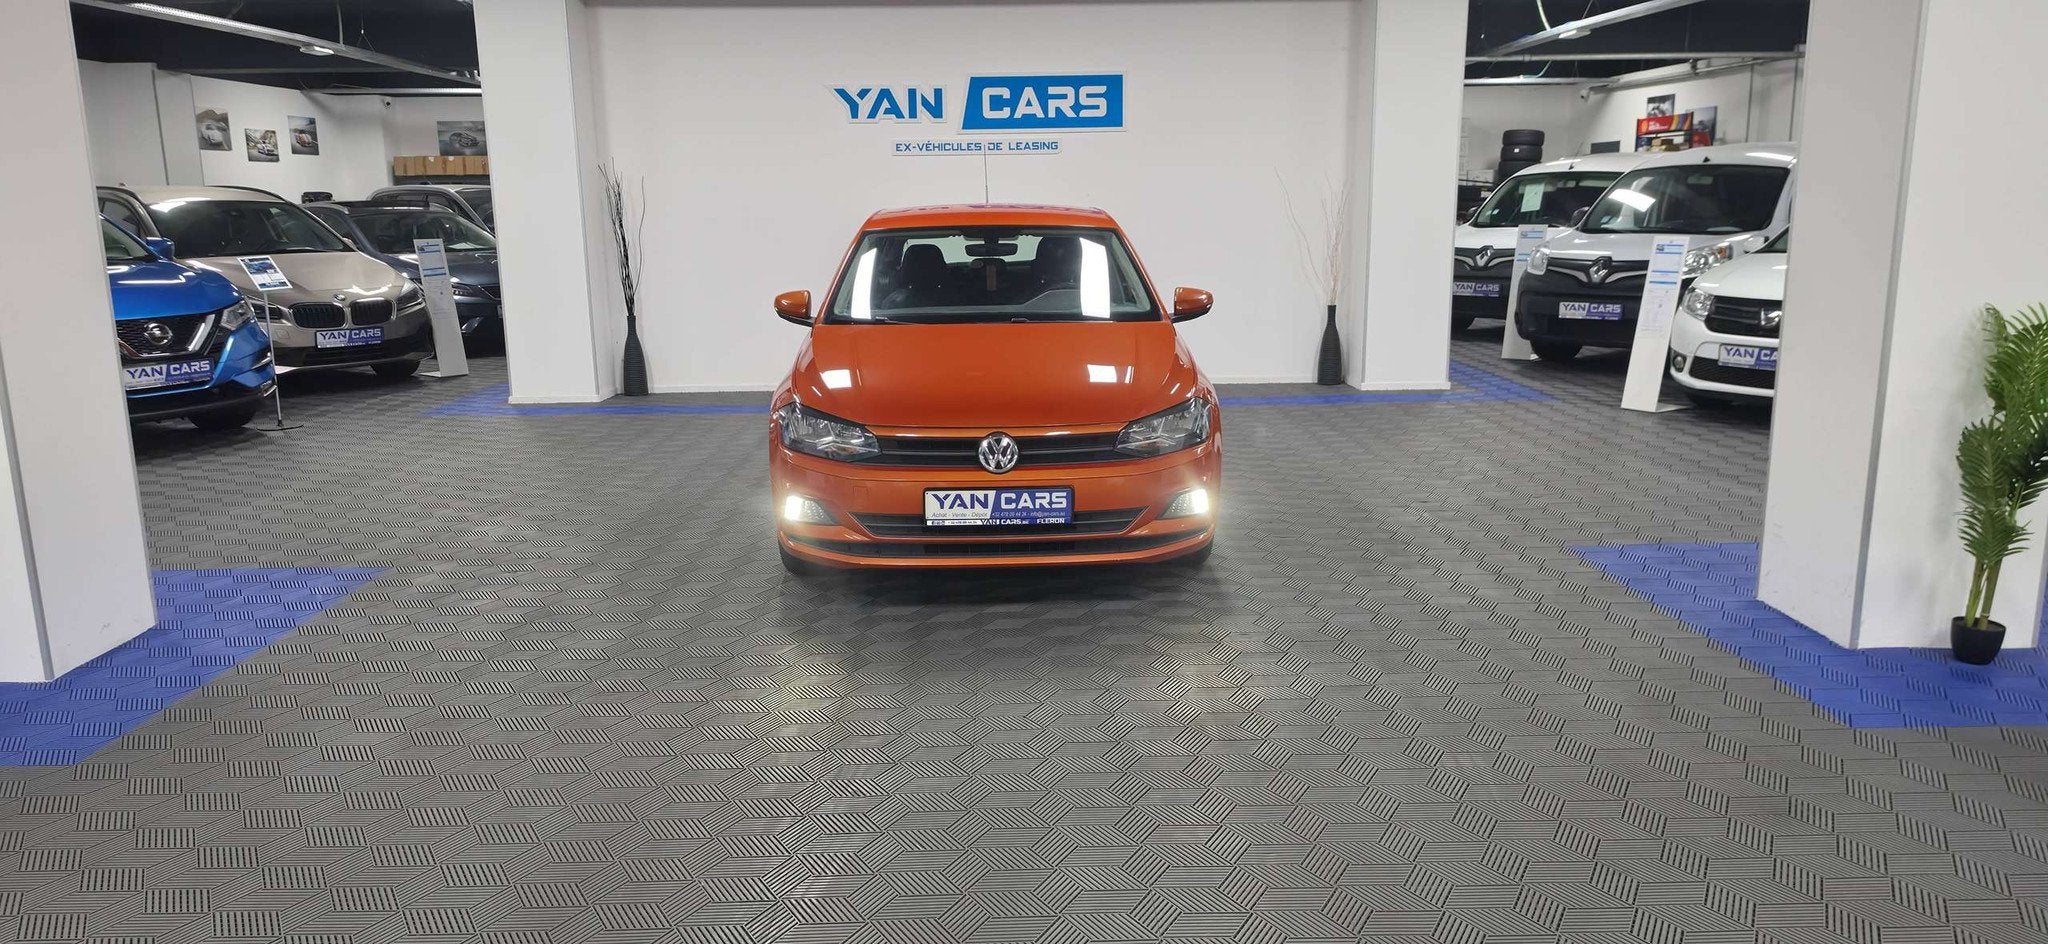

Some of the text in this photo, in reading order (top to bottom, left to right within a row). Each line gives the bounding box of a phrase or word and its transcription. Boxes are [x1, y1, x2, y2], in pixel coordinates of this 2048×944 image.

[833, 85, 1107, 119] YAN CARS
[895, 140, 1059, 152] EX-VÉHICULES DE LEASING
[1562, 303, 1621, 313] YAN CARS
[319, 328, 381, 341] YAN CARS
[1724, 346, 1755, 359] YAN
[126, 366, 163, 379] YAN
[169, 360, 210, 375] CARS
[931, 492, 1067, 510] YAN CARS
